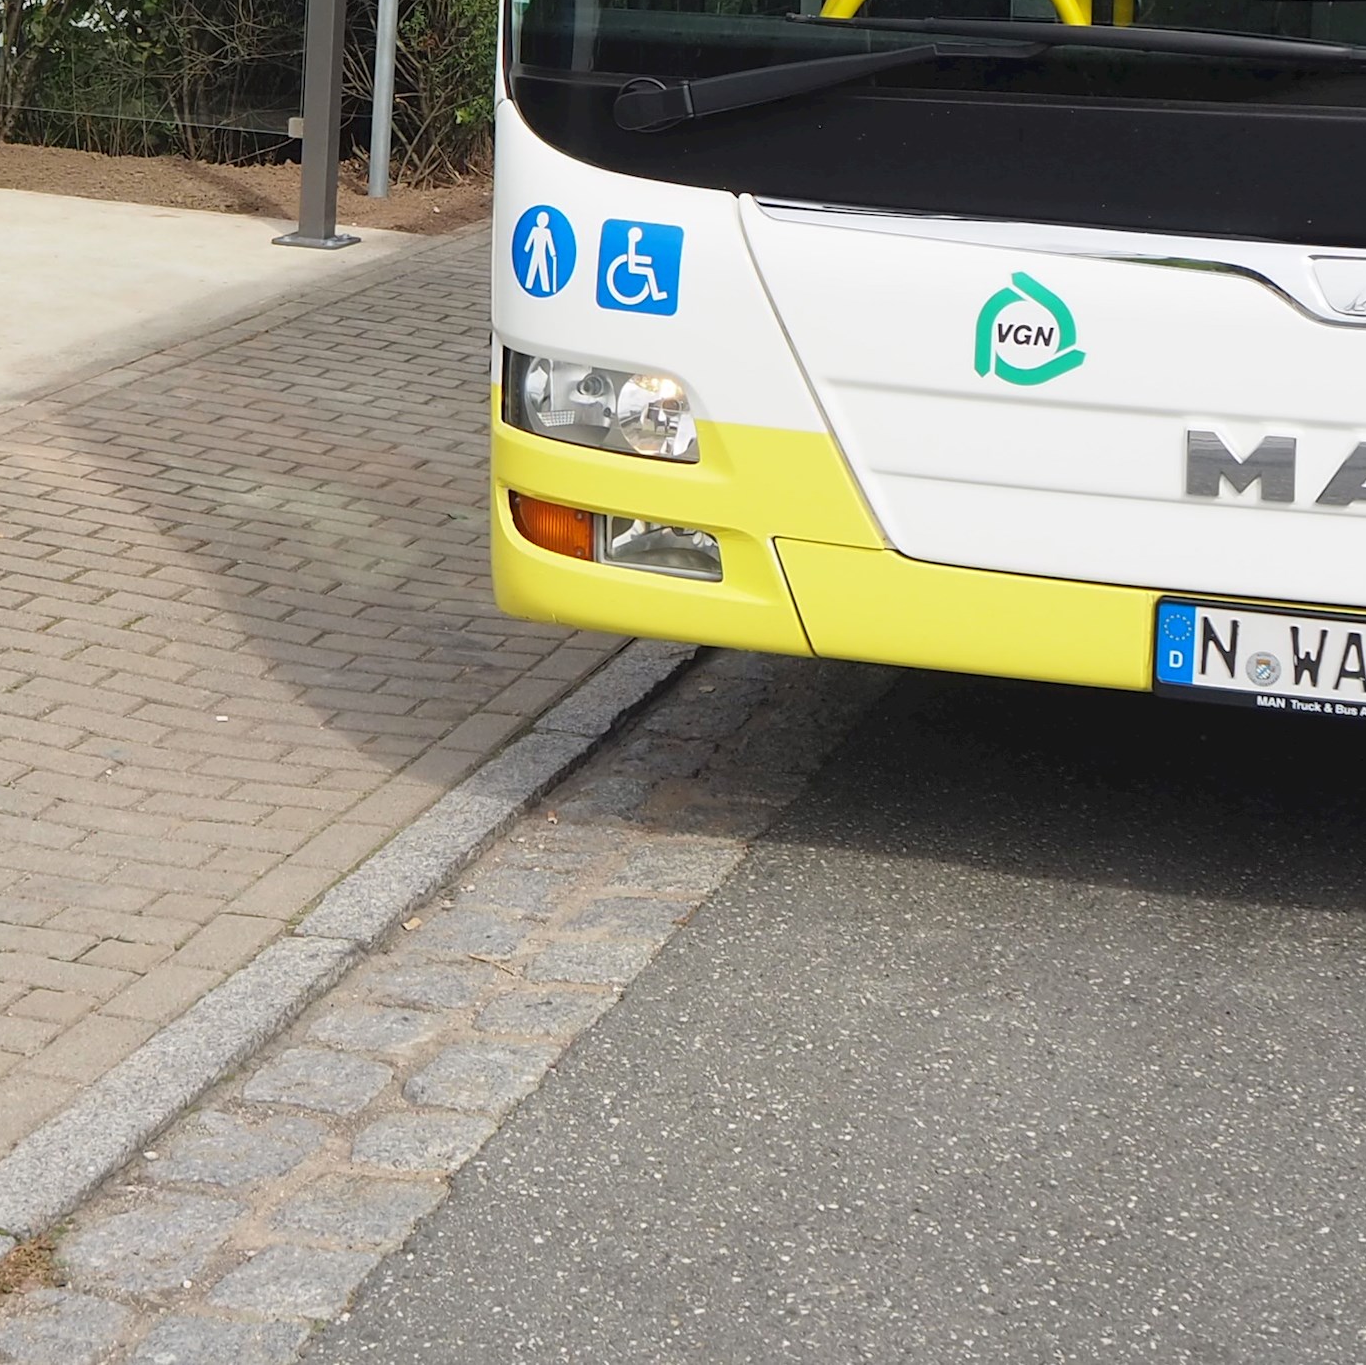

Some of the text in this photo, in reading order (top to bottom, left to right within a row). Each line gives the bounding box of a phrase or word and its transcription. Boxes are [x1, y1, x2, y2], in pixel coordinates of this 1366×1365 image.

[998, 323, 1055, 347] VGN
[1199, 614, 1240, 679] N
[1168, 650, 1183, 669] D
[1257, 696, 1286, 709] MAN
[1290, 699, 1322, 714] Truck
[1323, 702, 1333, 714] &
[1335, 703, 1358, 717] Bus
